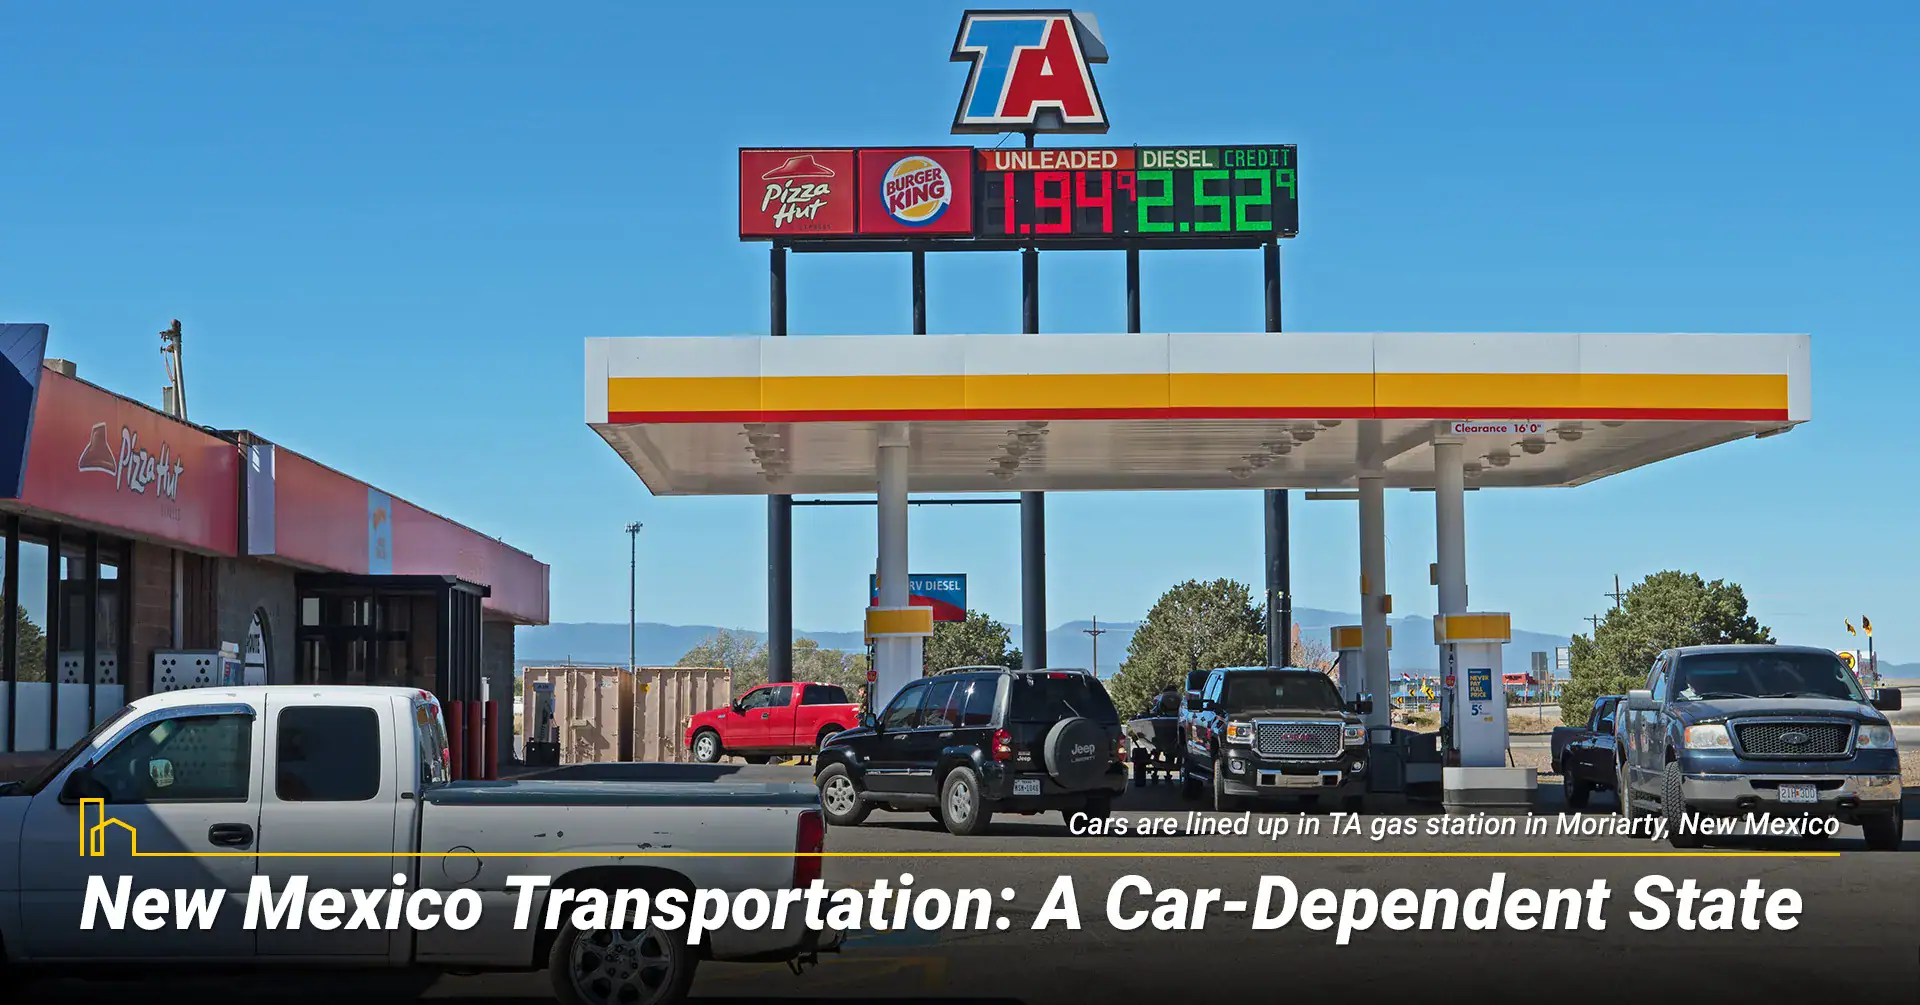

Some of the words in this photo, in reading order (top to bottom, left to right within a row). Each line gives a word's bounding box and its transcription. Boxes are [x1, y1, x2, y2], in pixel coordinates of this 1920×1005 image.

[961, 15, 1102, 123] TA
[995, 149, 1118, 169] UNLEADED
[1143, 149, 1213, 167] DIESEL
[1224, 149, 1290, 167] CREDIT
[886, 167, 942, 197] BURGER
[761, 180, 831, 212] Pizza
[889, 180, 945, 215] KING
[773, 199, 828, 228] Hut
[1455, 424, 1507, 433] Clearance
[116, 427, 155, 494] Pizza
[156, 441, 184, 502] Hut
[909, 581, 923, 591] RV
[926, 581, 961, 591] DIESEL
[1071, 743, 1096, 755] Jeep
